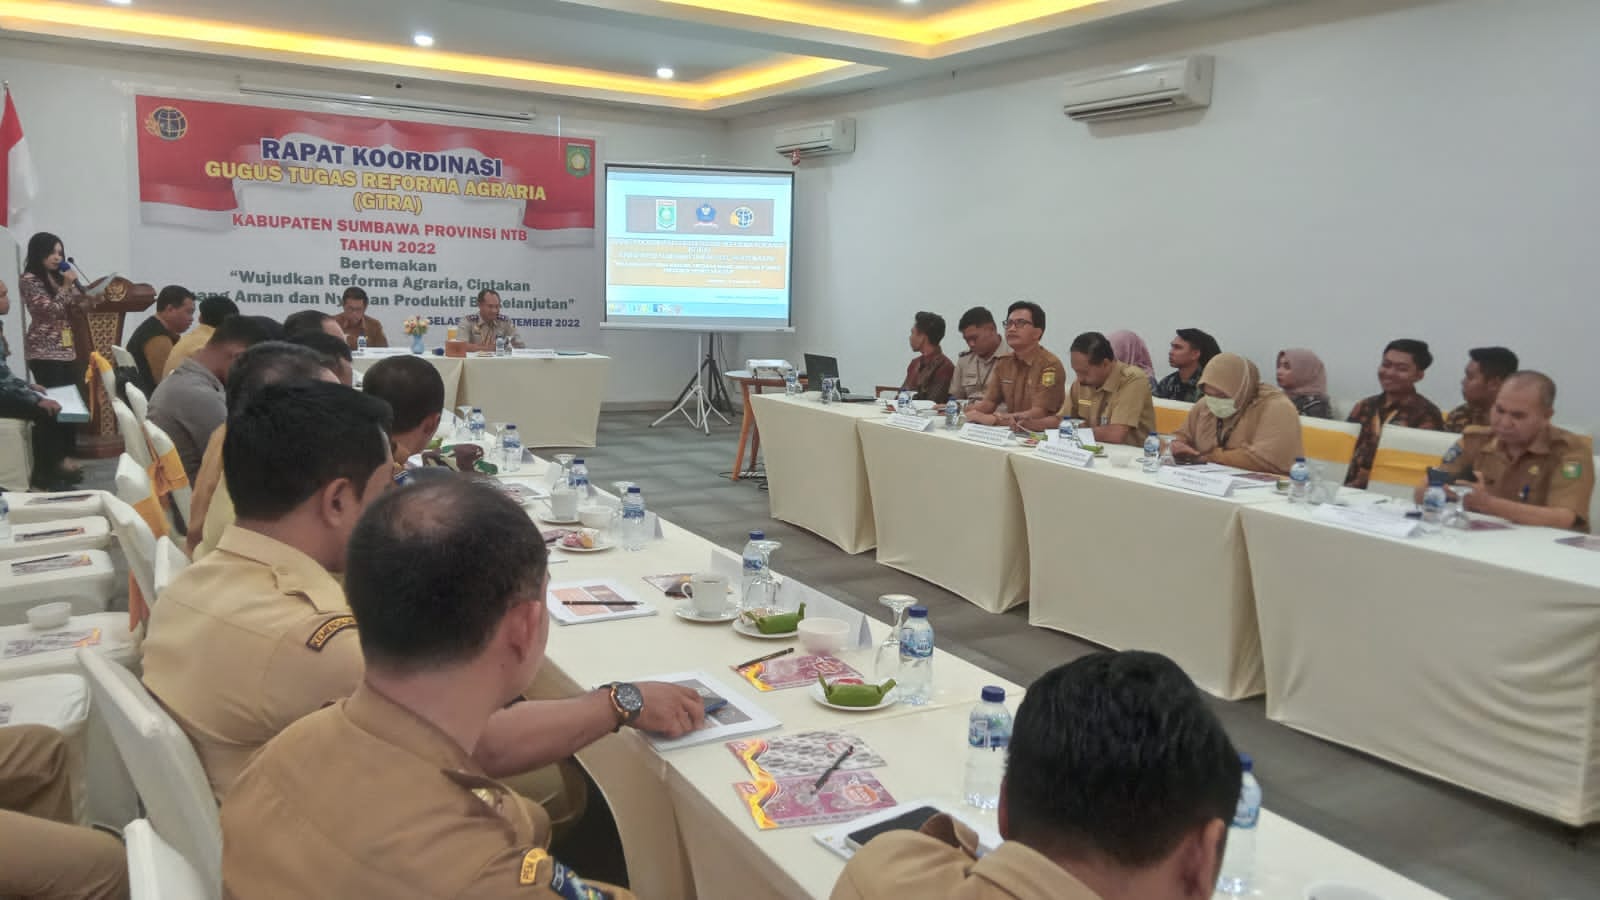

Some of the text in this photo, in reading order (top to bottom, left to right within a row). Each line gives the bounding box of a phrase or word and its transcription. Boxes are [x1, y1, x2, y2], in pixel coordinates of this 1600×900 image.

[261, 139, 502, 177] RAPAT KOORDINASI
[204, 160, 547, 200] GUGUS TUGAS REFORMA AGRARIA
[353, 192, 423, 216] (GTRA)
[232, 213, 528, 241] KABUPATEN SUMBAWA PROVINSI NTB
[339, 238, 437, 255] TAHUN 2022
[339, 256, 437, 272] Bertemakan
[328, 273, 398, 288] Reforma
[402, 276, 463, 292] Agraria,
[466, 278, 531, 292] Ciptakan
[235, 290, 284, 304] Aman
[288, 291, 322, 304] dan
[325, 292, 390, 307] Nyan
[394, 294, 467, 308] Produktif
[469, 296, 575, 312] Belanjutan"
[427, 316, 581, 328] SELAS TEMBER 2022
